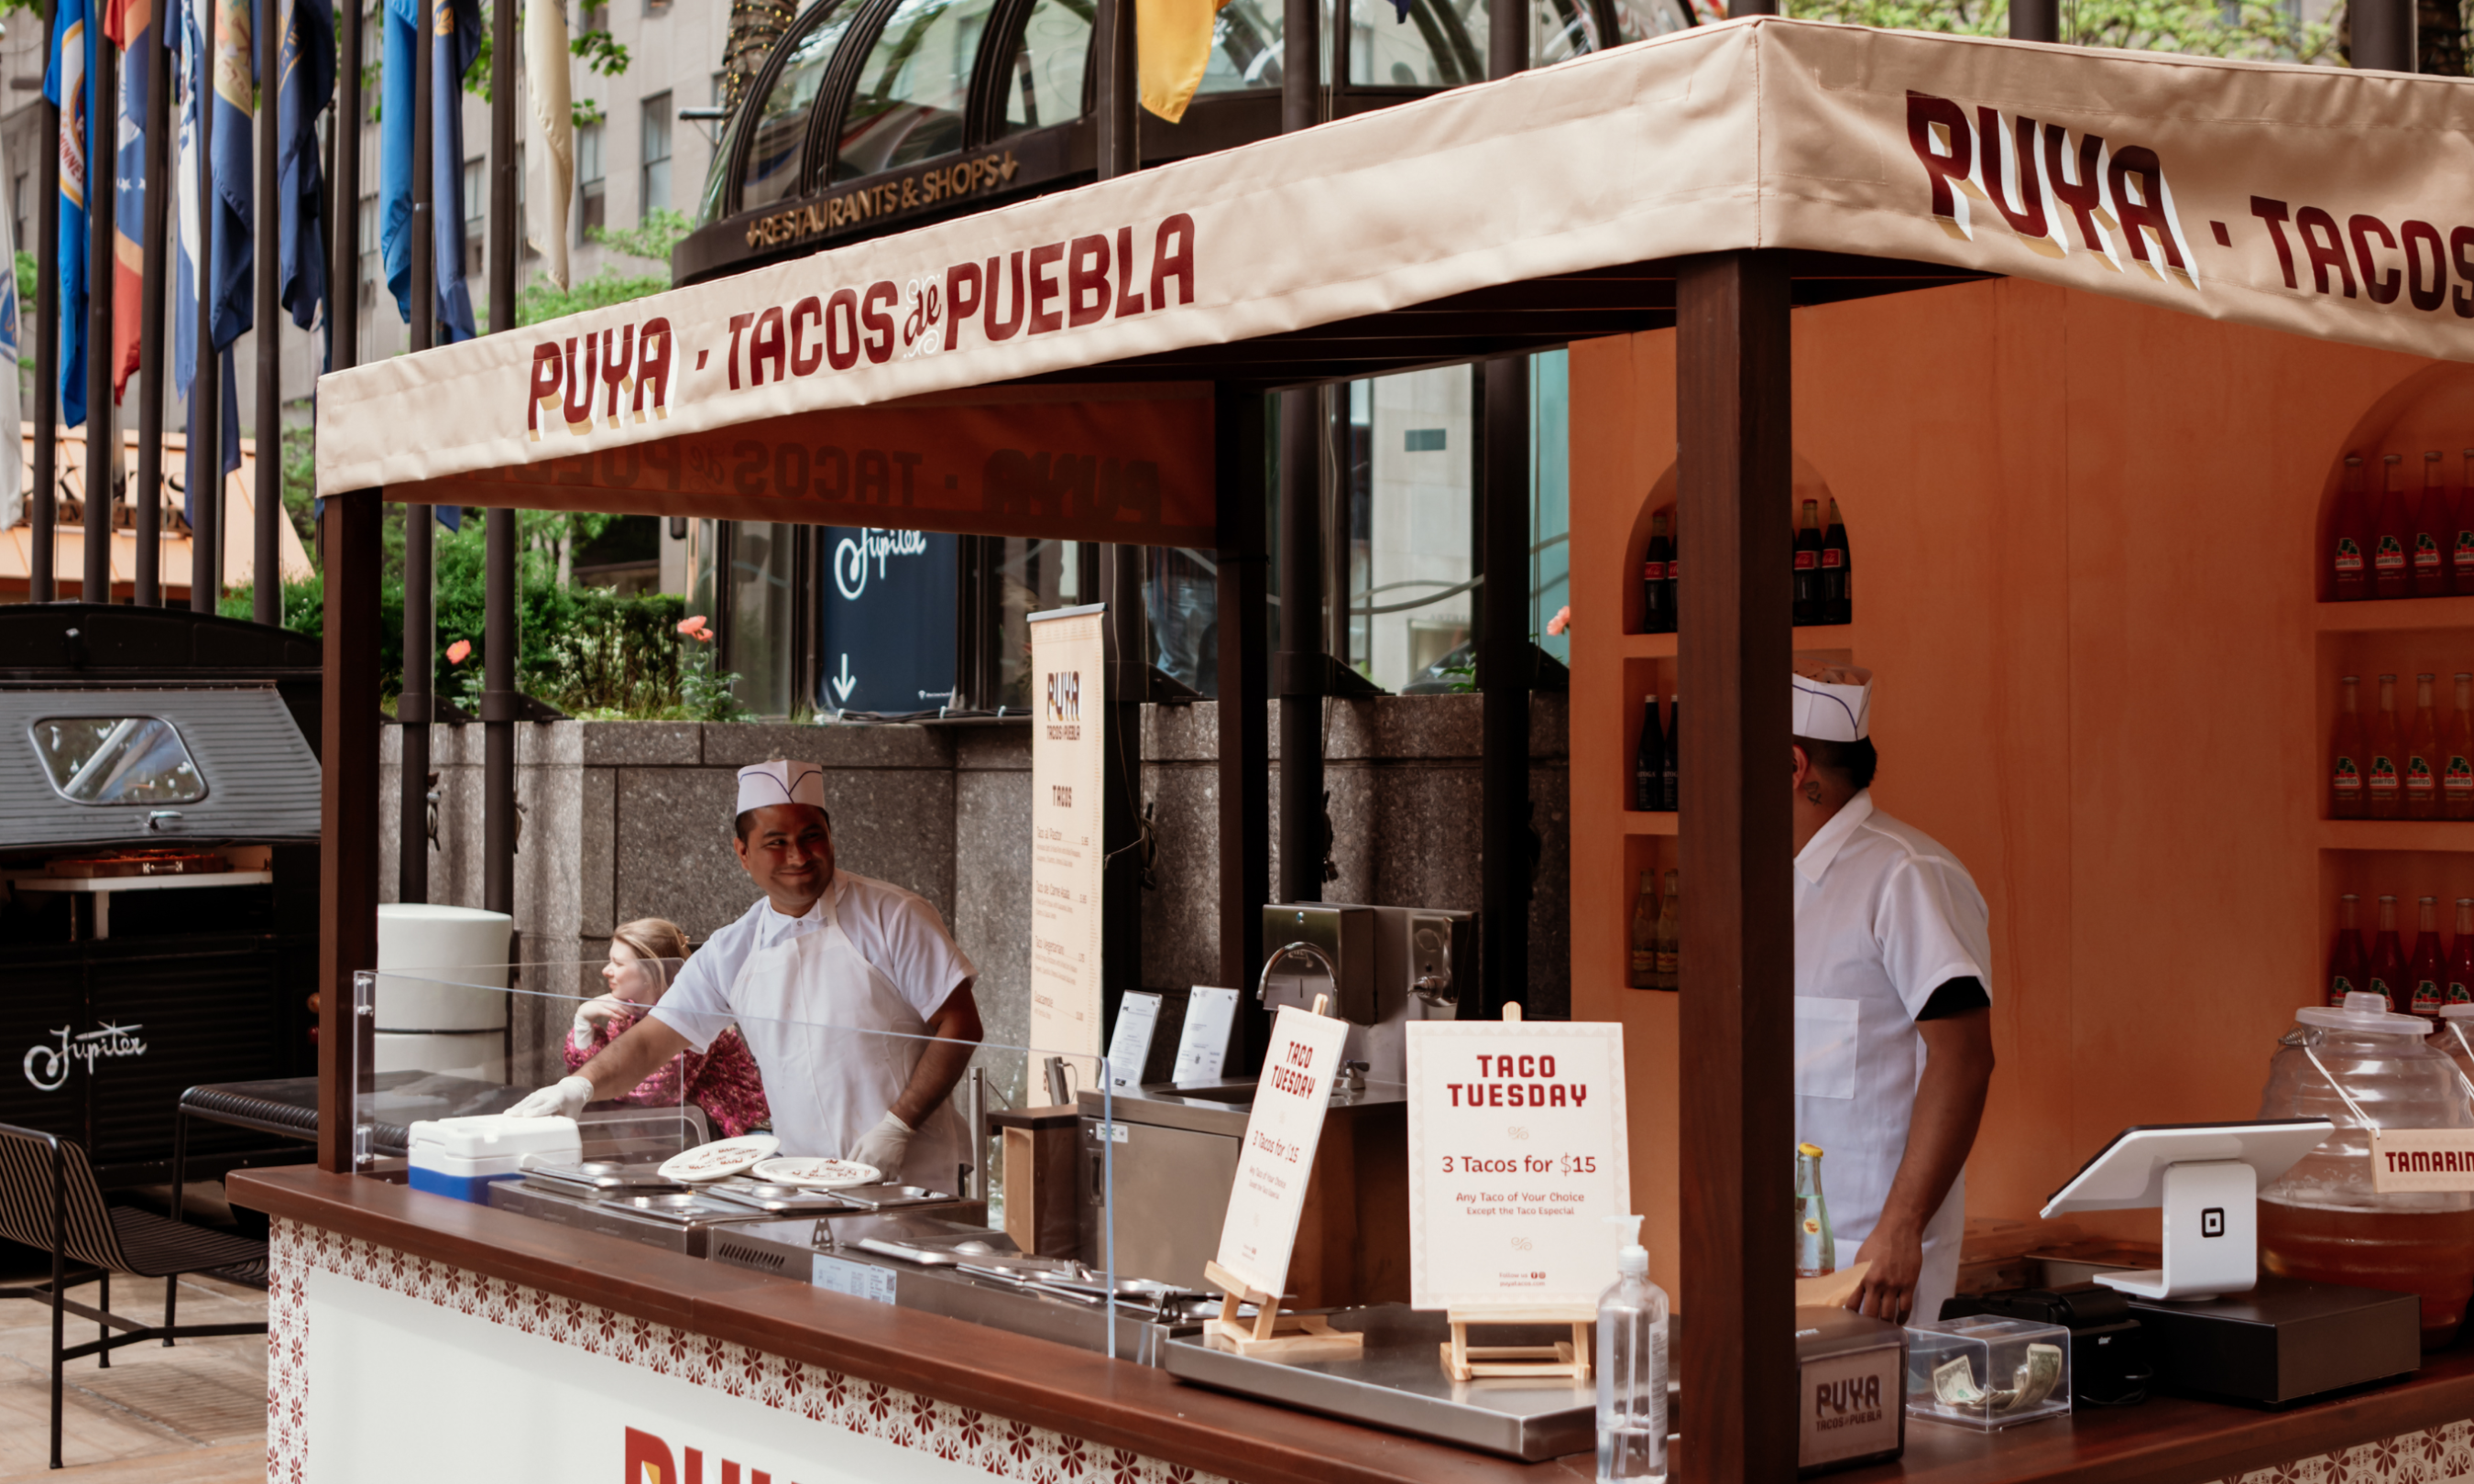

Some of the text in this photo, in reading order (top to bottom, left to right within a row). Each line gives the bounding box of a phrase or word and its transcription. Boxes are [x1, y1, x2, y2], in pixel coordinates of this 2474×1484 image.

[760, 154, 1001, 246] RESTAURANTS & SHOPS
[1906, 89, 2201, 291] PUYA
[528, 212, 1196, 441] PUYA TACOS de PUEBLA
[1047, 671, 1081, 721] PUYA
[1046, 725, 1062, 740] TACOS
[1053, 784, 1072, 808] TACOS
[24, 1020, 148, 1091] Jupiter
[1286, 1041, 1313, 1069] TACO
[1476, 1054, 1556, 1078] TACO
[1271, 1064, 1316, 1100] TUESDAY
[1447, 1083, 1587, 1108] TUESDAY
[1253, 1129, 1300, 1163] 3 Tacos for $15
[1441, 1151, 1596, 1177] 3 Tacos for $15
[1456, 1192, 1584, 1204] Any Taco of Your Choice
[1466, 1206, 1575, 1217] Except the Taco Especial
[1816, 1375, 1882, 1417] PUYA
[1816, 1416, 1844, 1432] TACOS
[1849, 1409, 1882, 1425] PUEBLA
